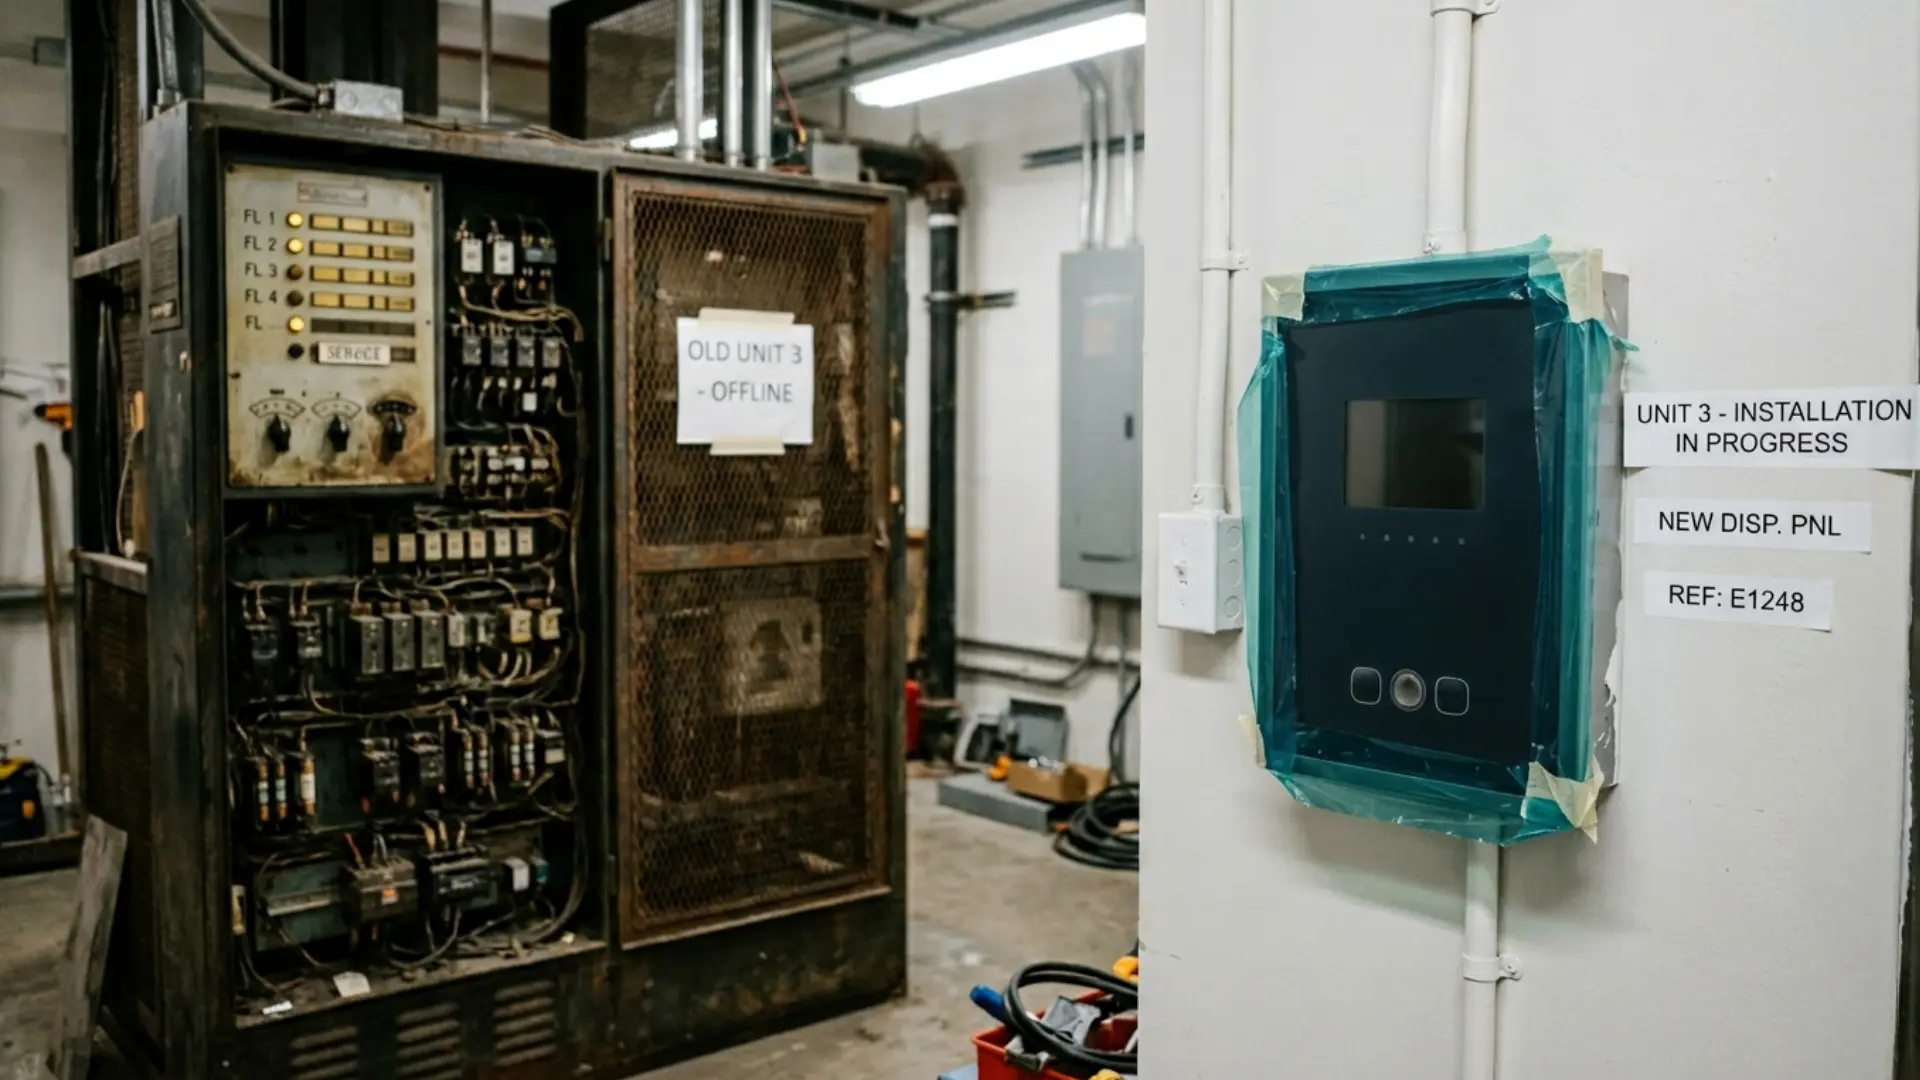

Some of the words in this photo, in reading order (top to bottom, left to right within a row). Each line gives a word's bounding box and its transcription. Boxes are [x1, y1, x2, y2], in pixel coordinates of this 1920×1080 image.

[243, 208, 261, 225] FL
[269, 211, 275, 226] 1
[243, 234, 262, 251] FL
[268, 237, 278, 252] 2
[244, 261, 262, 278] FL
[268, 263, 278, 279] 3
[244, 287, 262, 304] FL
[268, 289, 278, 304] 4
[244, 314, 263, 331] FL
[687, 339, 731, 362] OLD
[737, 342, 784, 363] UNIT
[791, 344, 804, 365] 3
[711, 380, 794, 404] OFFLINE
[1637, 403, 1692, 424] UNIT
[1698, 403, 1712, 423] 3
[1734, 398, 1912, 423] INSTALLATION
[1676, 433, 1699, 453] IN
[1706, 431, 1849, 454] PROGRESS
[1658, 511, 1714, 532] NEW
[1721, 512, 1782, 535] DISP.
[1791, 514, 1842, 536] PNL
[1668, 584, 1722, 608] REF:
[1730, 587, 1805, 613] E1248
